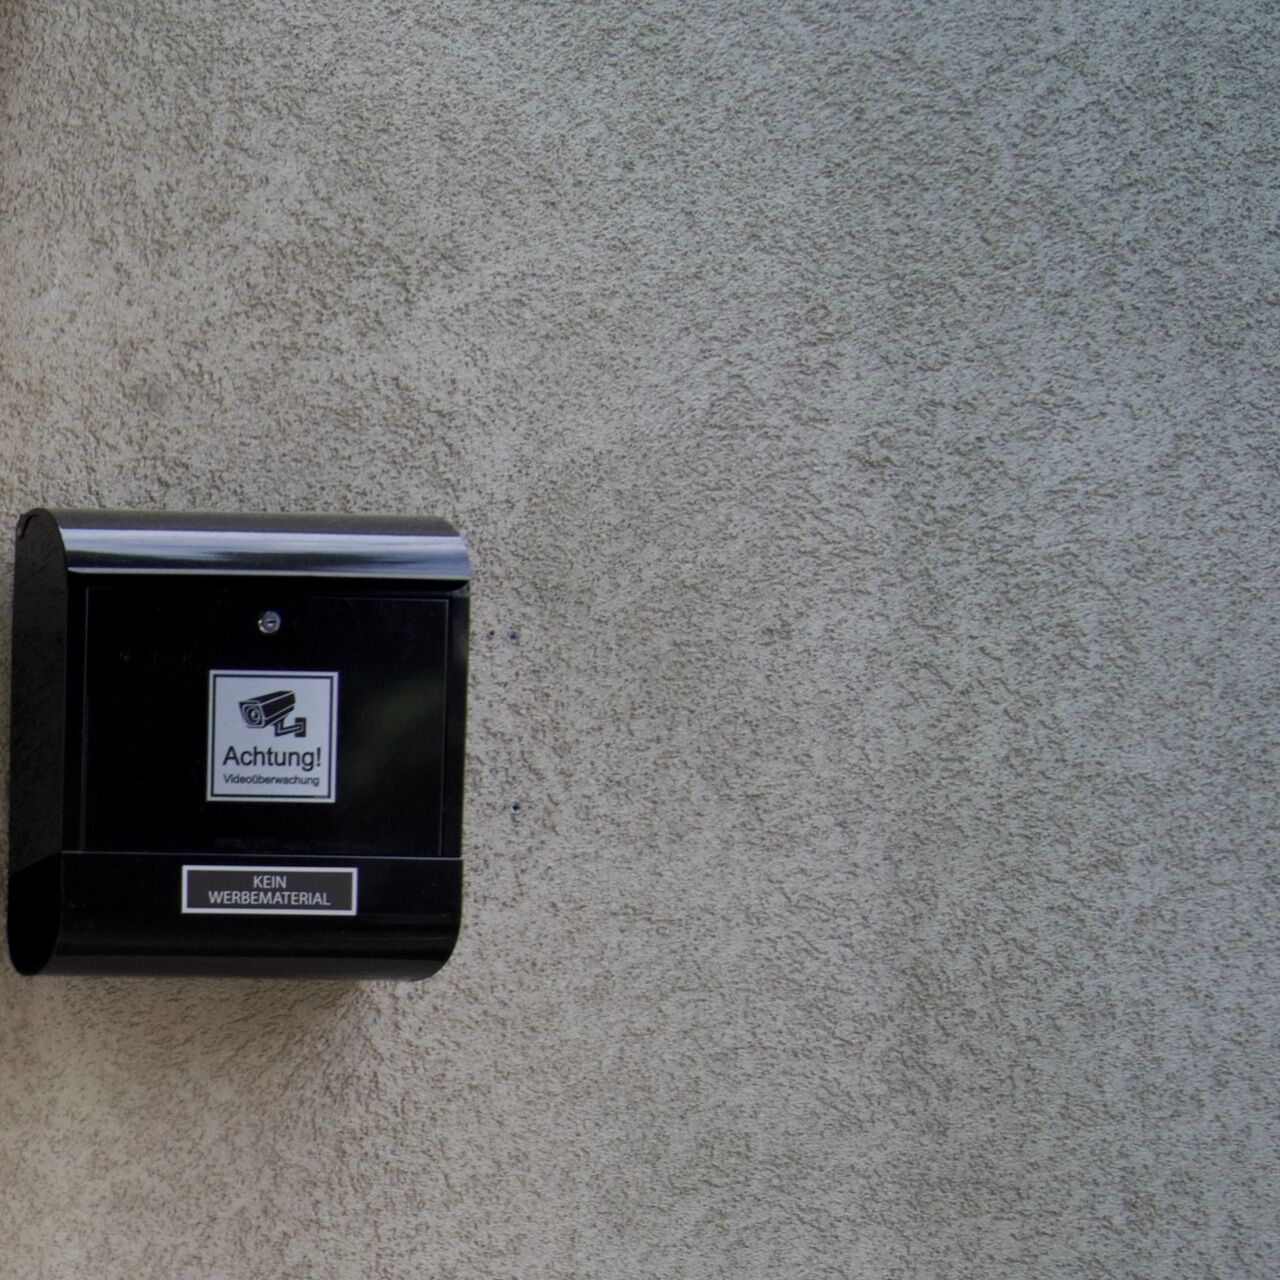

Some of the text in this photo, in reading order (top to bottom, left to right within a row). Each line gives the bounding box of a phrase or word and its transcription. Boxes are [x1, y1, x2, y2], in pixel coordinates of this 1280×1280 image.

[222, 746, 321, 772] Achtung!
[223, 773, 320, 787] Videoüberwachung
[253, 875, 287, 889] KEIN
[208, 890, 331, 905] WERBEMATERIAL
